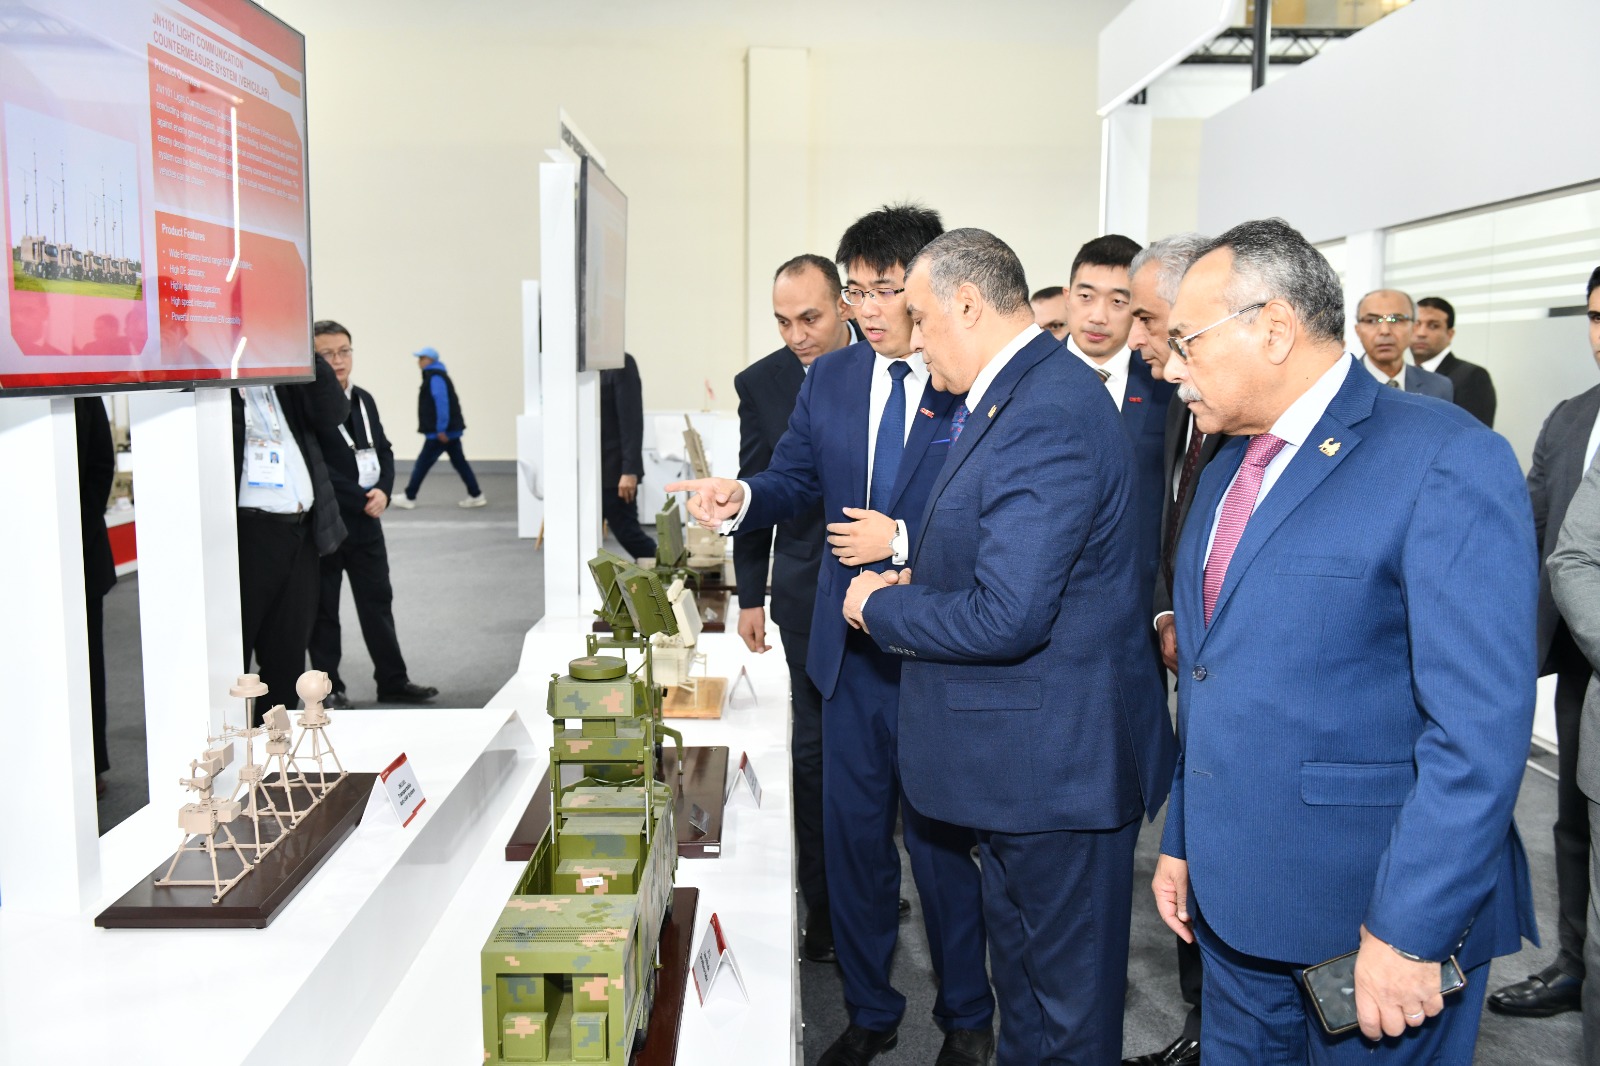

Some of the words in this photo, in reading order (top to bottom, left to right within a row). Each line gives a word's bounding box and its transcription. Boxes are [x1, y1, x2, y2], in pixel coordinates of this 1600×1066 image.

[153, 12, 175, 34] JN1101
[176, 25, 195, 45] LIGHT
[196, 35, 244, 70] COMMUNICATION
[153, 30, 214, 72] COUNTERMEASURE
[215, 62, 238, 83] SYSTEM
[238, 74, 270, 101] (VEHICULAR)
[154, 57, 176, 76] Product
[161, 223, 184, 238] Product
[184, 227, 206, 242] Features
[169, 263, 180, 275] High
